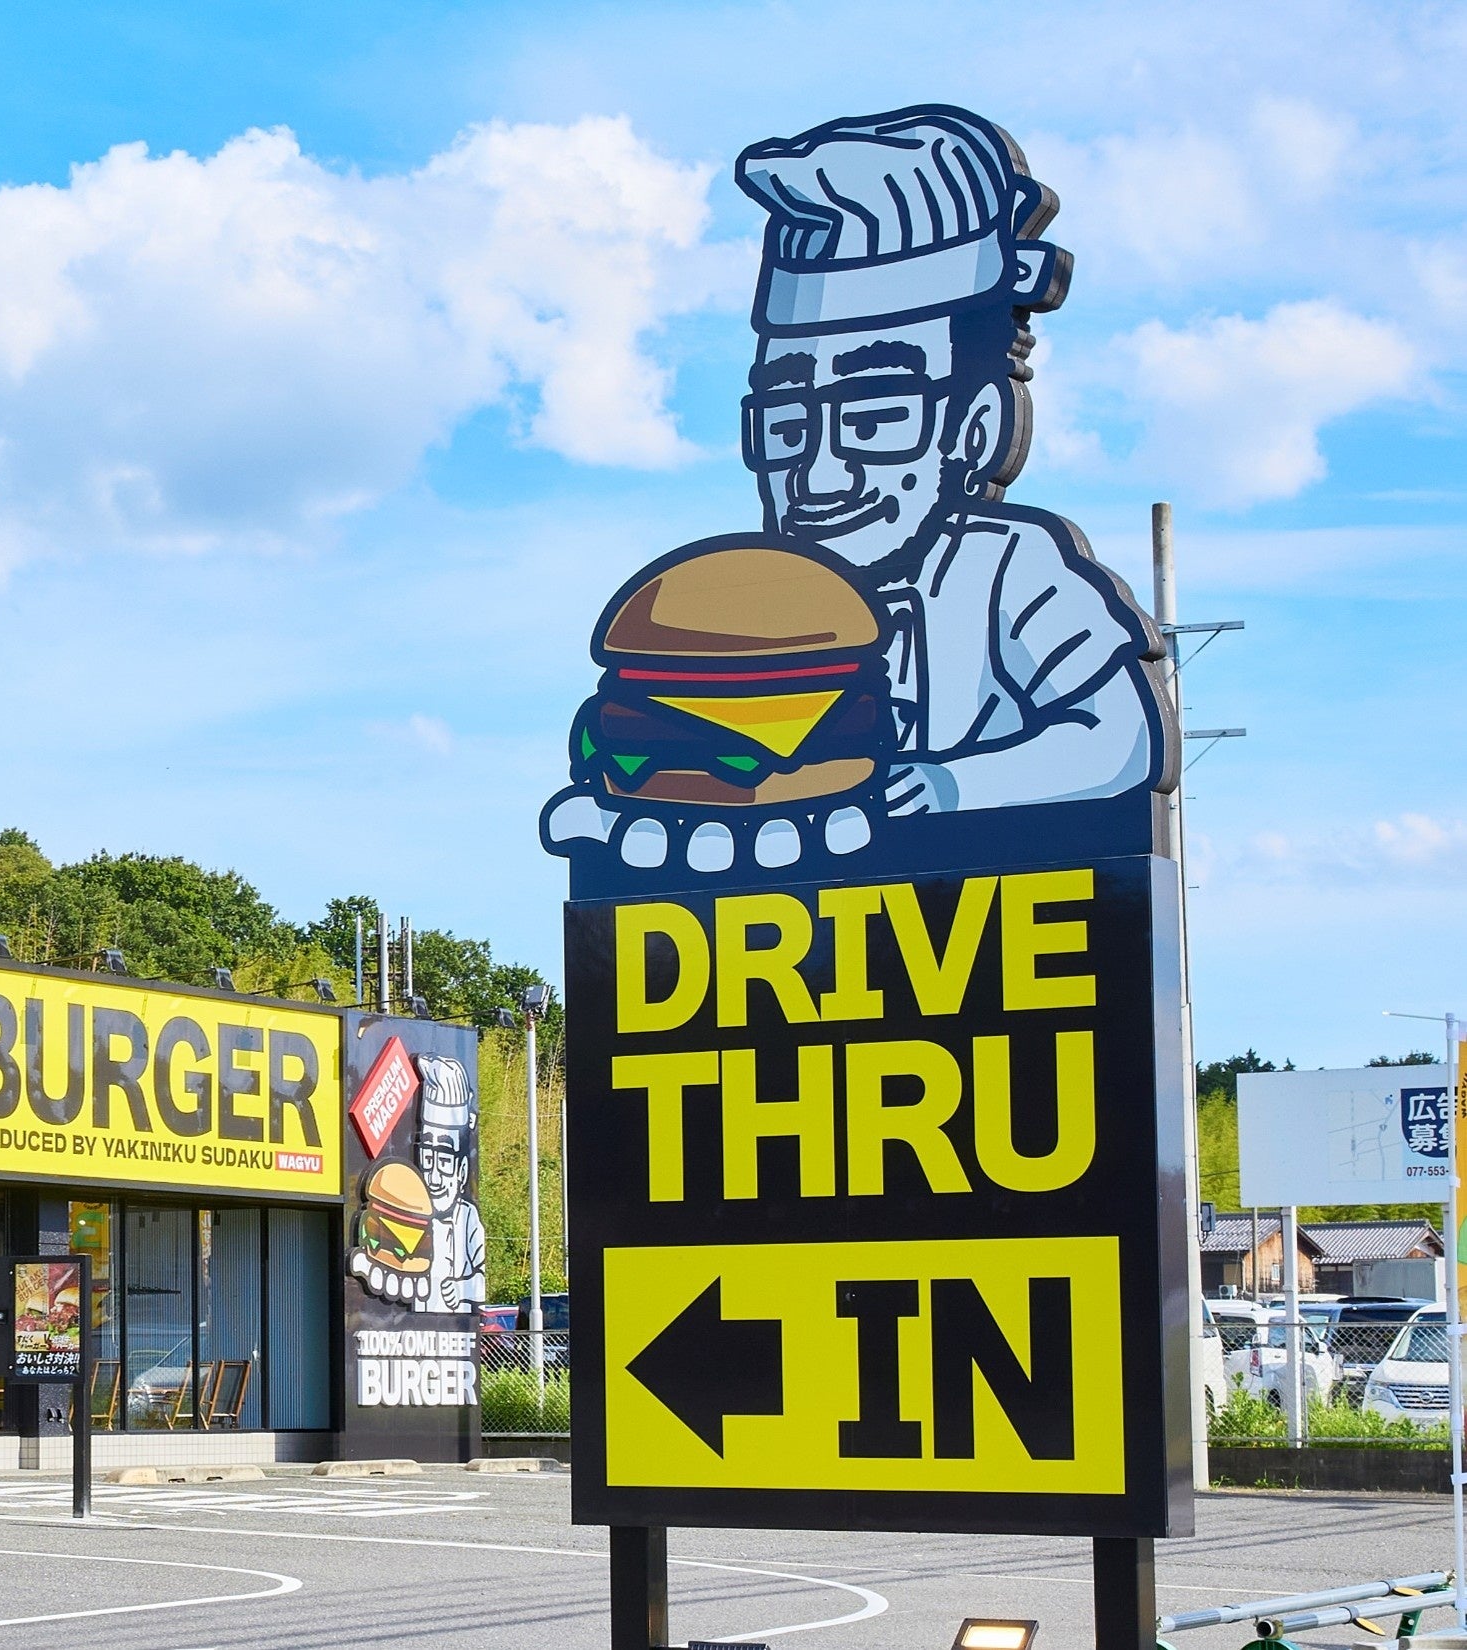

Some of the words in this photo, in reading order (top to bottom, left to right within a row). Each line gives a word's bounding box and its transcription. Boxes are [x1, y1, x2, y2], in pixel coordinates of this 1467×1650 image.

[615, 868, 1096, 1034] DRIVE
[362, 1054, 403, 1125] PREMIUM
[369, 1067, 411, 1140] WAGYU
[611, 1030, 1096, 1202] THRU
[72, 1135, 97, 1156] BY
[101, 1137, 197, 1164] YAKINIKU
[201, 1145, 273, 1170] SUDAKU
[277, 1154, 321, 1172] WAGYU
[354, 1330, 403, 1356] 100%
[402, 1330, 437, 1356] OMI
[438, 1331, 477, 1356] BEEF
[835, 1276, 1075, 1461] IN
[358, 1359, 478, 1406] BURGER
